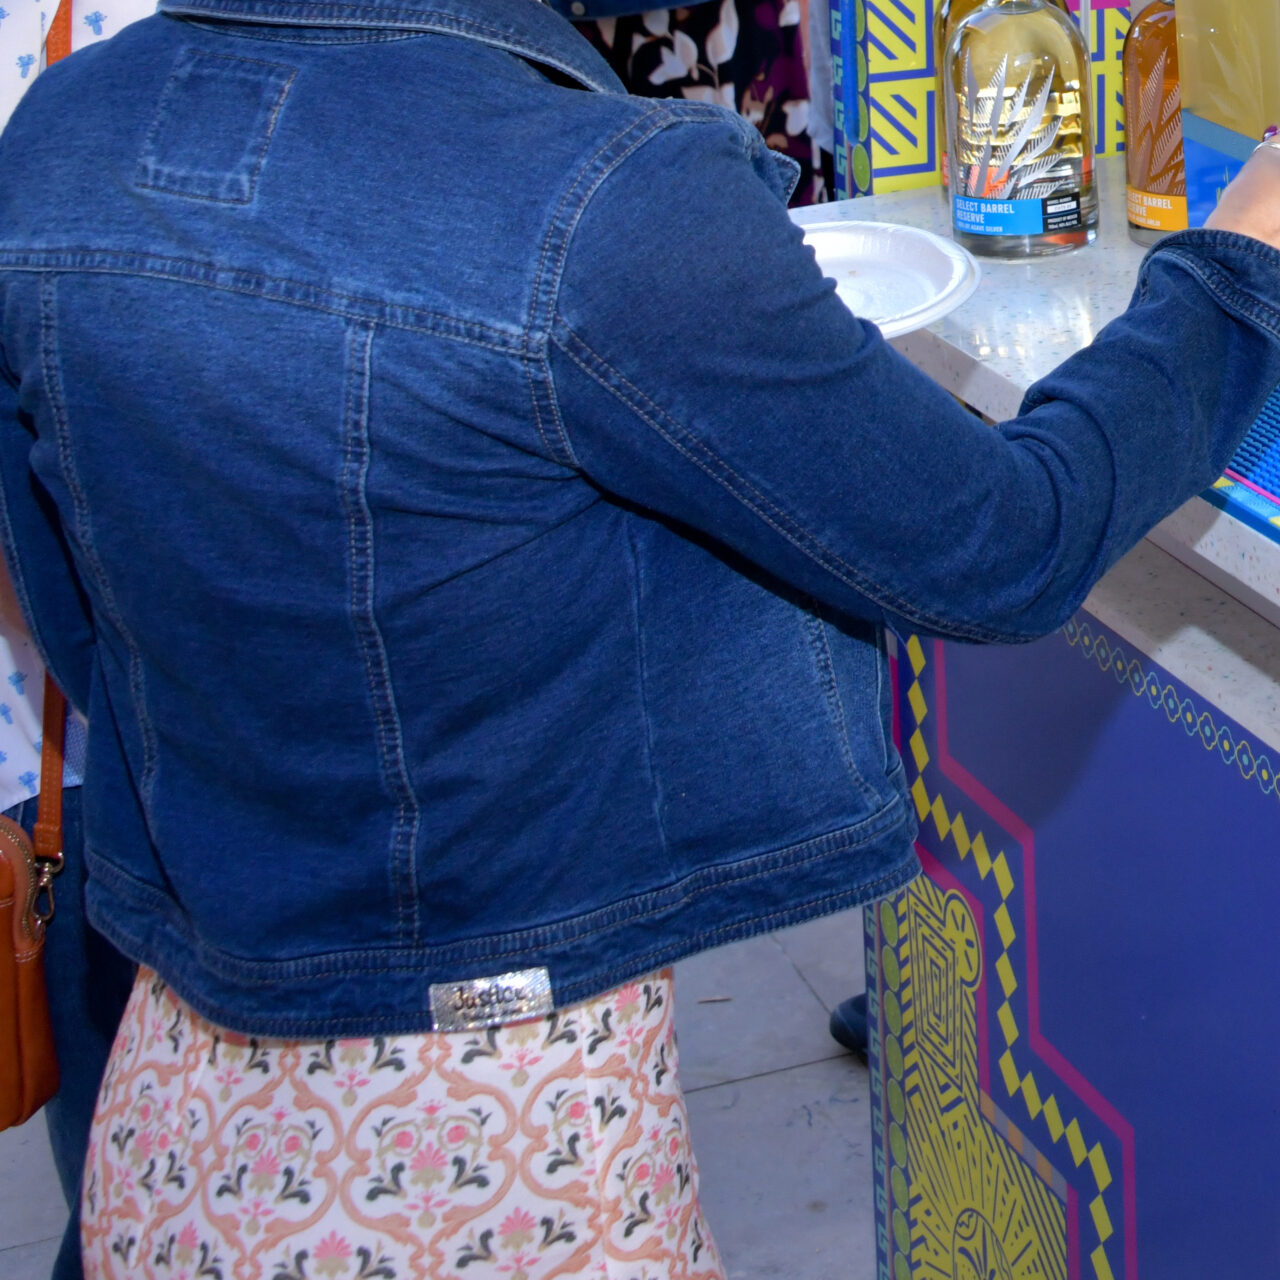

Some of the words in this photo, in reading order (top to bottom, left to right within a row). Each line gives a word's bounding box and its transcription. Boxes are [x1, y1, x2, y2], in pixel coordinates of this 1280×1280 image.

[956, 198, 978, 212] SELECT
[980, 203, 1015, 214] BARREL
[1143, 195, 1173, 209] BARREL
[956, 211, 985, 224] RESERVE
